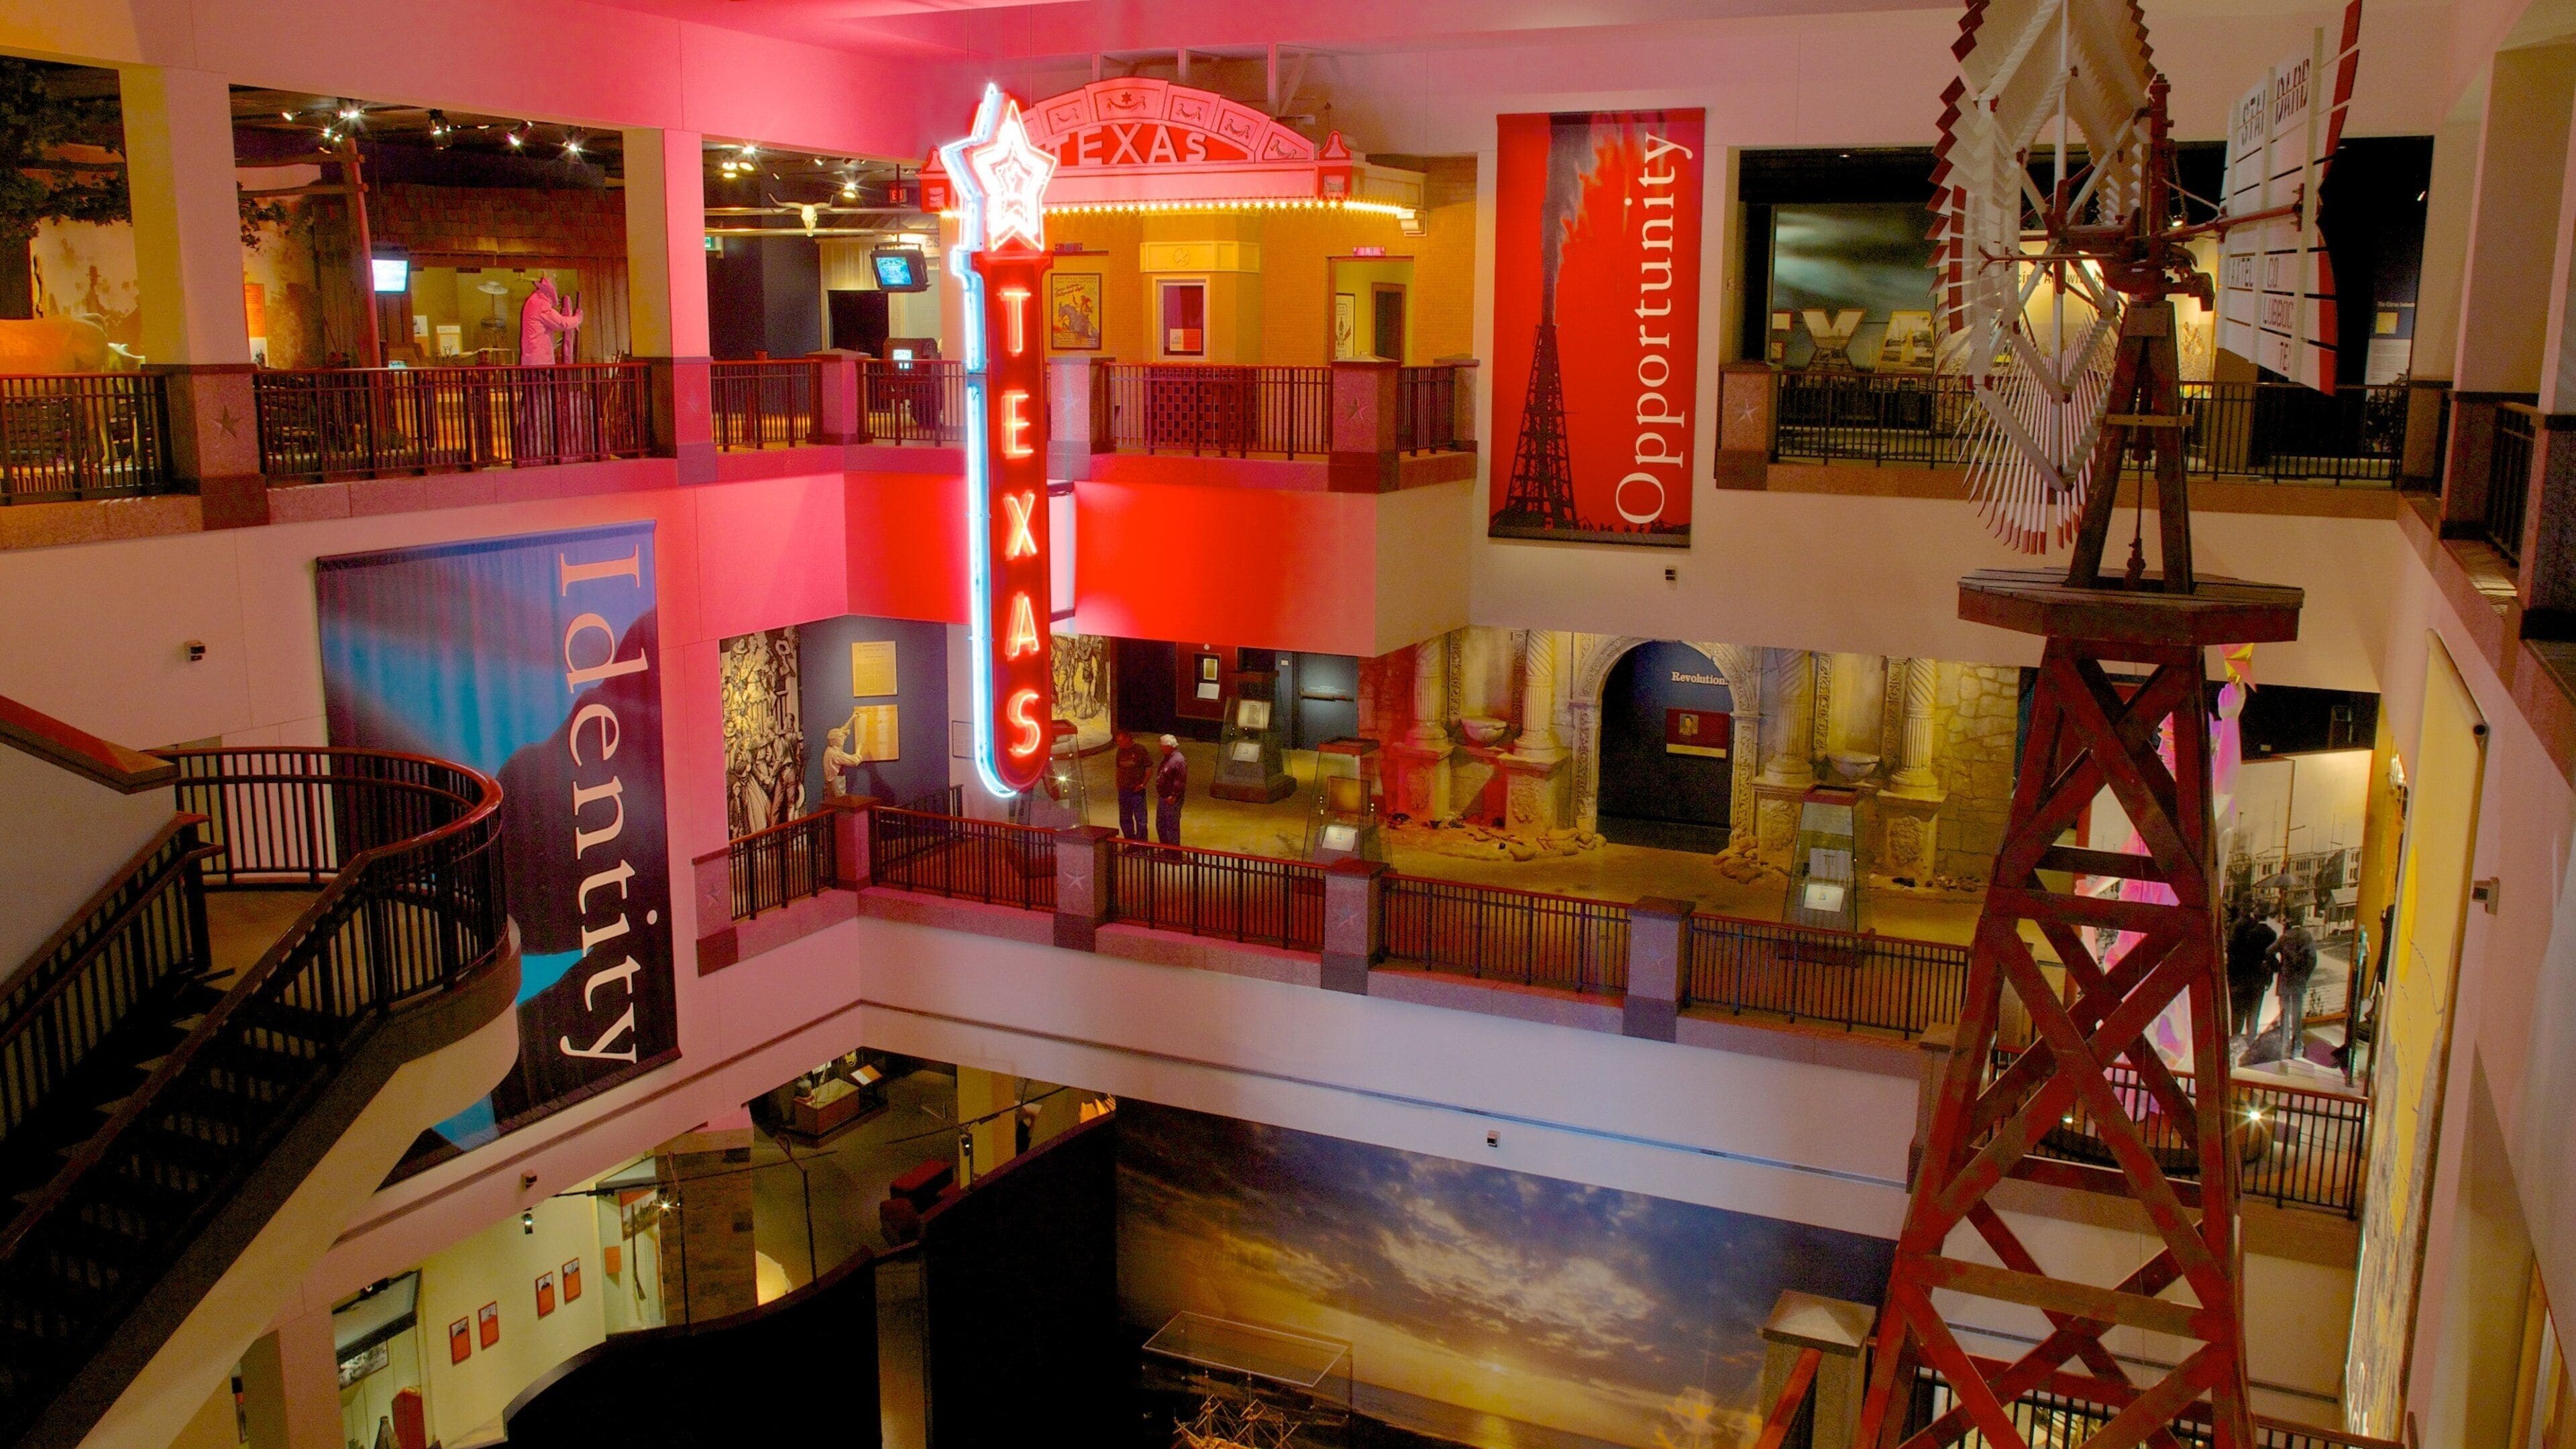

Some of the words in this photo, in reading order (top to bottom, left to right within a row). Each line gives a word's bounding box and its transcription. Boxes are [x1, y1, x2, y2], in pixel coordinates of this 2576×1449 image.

[1045, 123, 1208, 166] TEXAS
[1615, 131, 1693, 524] Opportunity
[996, 286, 1041, 759] TEXAS
[559, 544, 658, 1064] Identity
